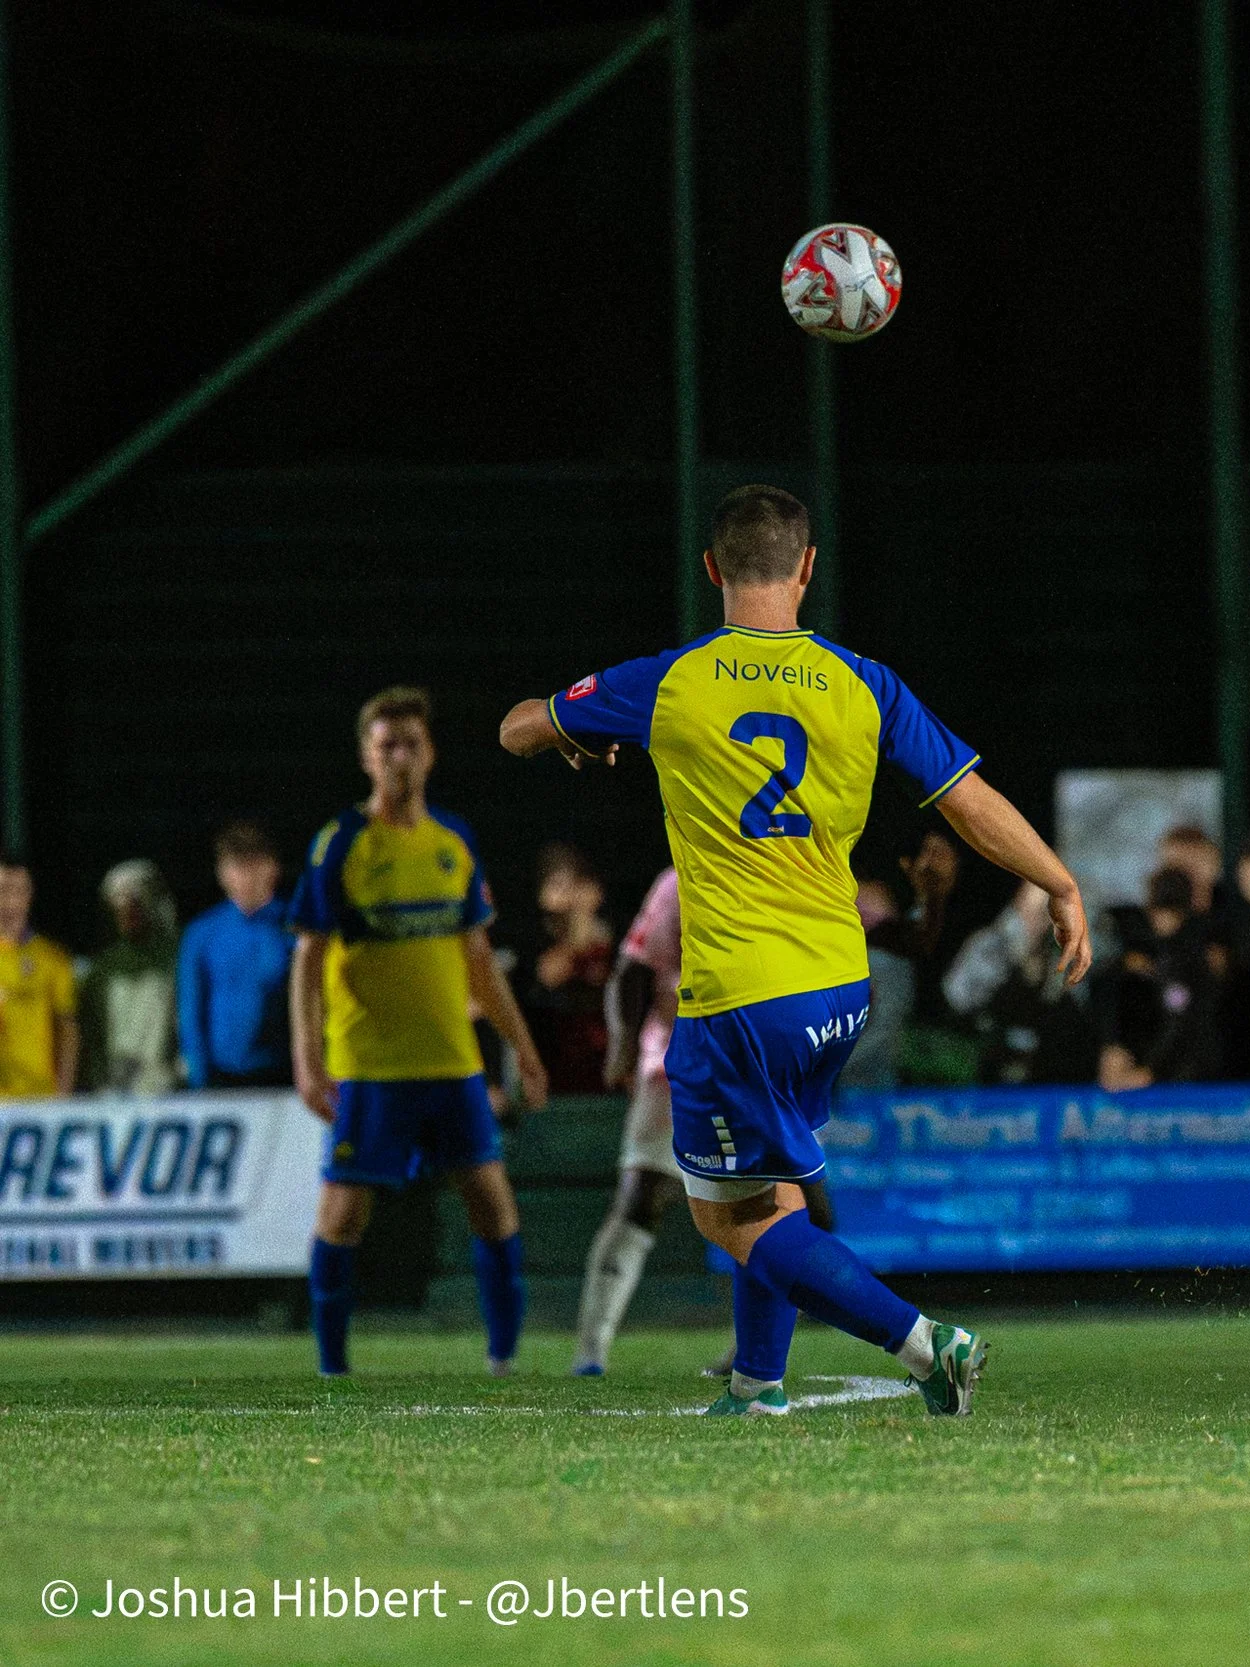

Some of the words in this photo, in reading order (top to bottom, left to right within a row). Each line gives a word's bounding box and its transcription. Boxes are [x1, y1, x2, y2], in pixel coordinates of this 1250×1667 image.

[715, 657, 829, 692] Novelis
[728, 711, 813, 839] 2
[0, 1117, 243, 1198] REVOR
